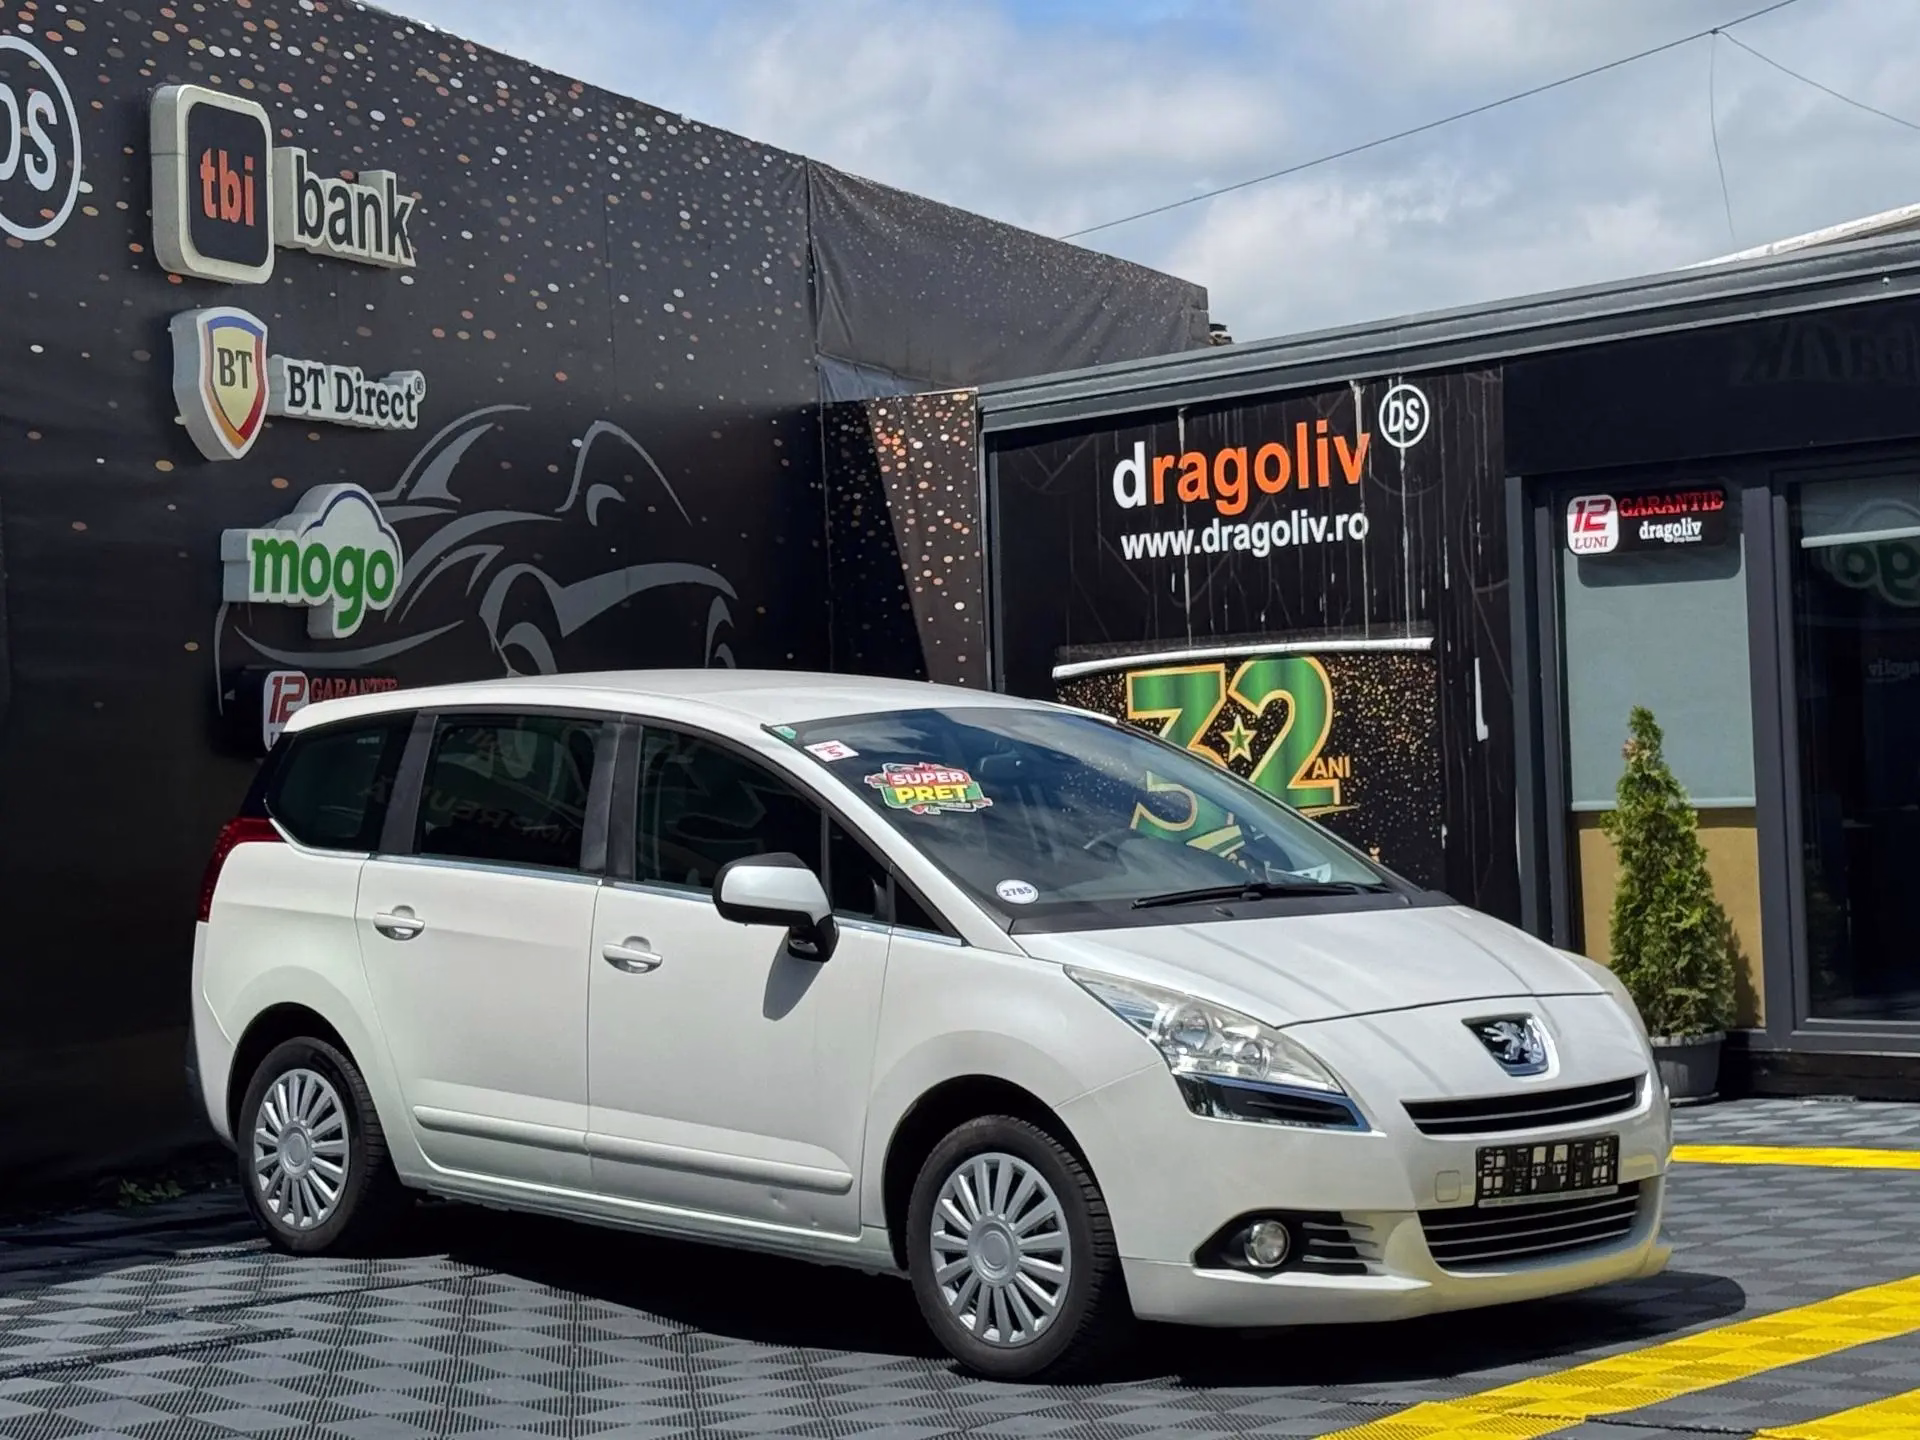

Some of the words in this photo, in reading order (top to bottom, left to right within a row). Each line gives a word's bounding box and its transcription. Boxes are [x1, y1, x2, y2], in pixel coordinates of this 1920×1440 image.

[200, 148, 255, 227] tbi
[296, 155, 412, 259] bank
[217, 348, 252, 389] BT
[288, 365, 325, 410] BT
[1388, 398, 1420, 433] DS
[1112, 419, 1371, 515] dragoliv
[1572, 499, 1611, 533] 12
[1620, 490, 1724, 517] GARANTIE
[1121, 508, 1370, 560] www.dragoliv.ro
[1574, 536, 1608, 549] LUNI
[1638, 517, 1702, 543] dragoliv
[251, 538, 394, 630] mogo
[891, 771, 965, 785] SUPER
[1312, 756, 1351, 780] ANI
[894, 784, 968, 803] PRET
